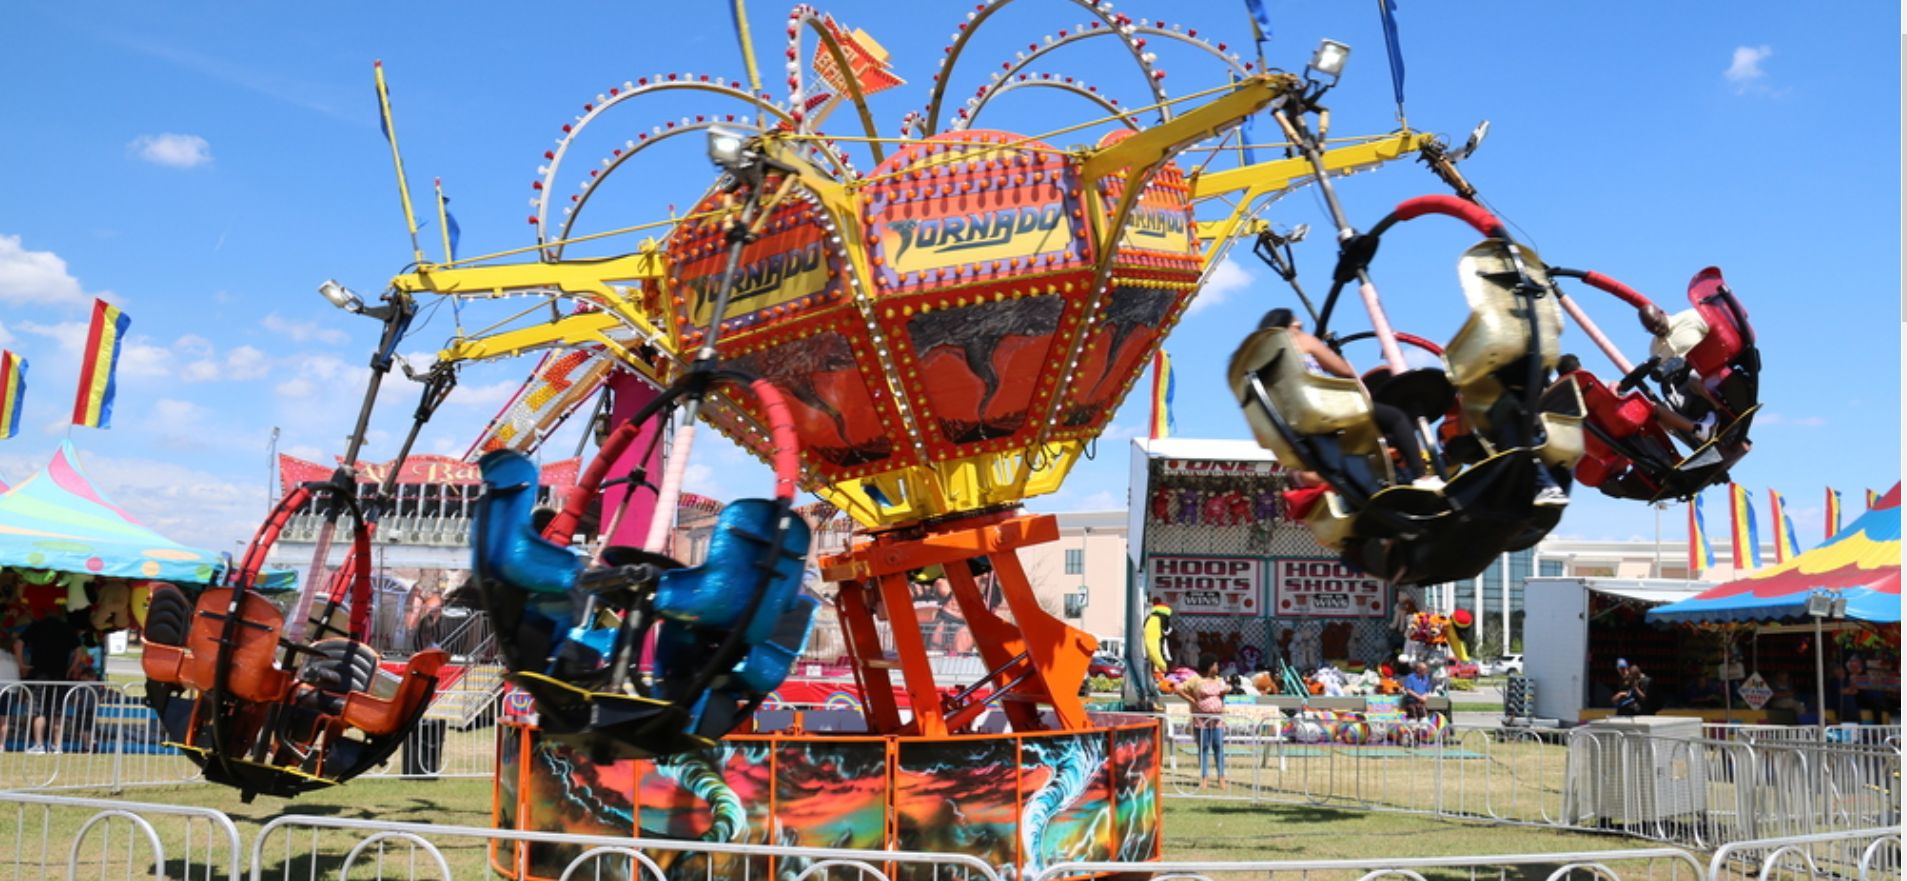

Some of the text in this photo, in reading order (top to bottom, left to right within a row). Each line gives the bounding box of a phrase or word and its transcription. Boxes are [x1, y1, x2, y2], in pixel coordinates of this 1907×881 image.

[1127, 208, 1184, 238] ORNADO
[885, 203, 1064, 264] TORNADO
[1156, 560, 1249, 575] HOOP
[1285, 563, 1364, 578] HOO
[1155, 576, 1249, 590] SHOTS
[1285, 579, 1378, 592] SHOTS
[1186, 596, 1219, 606] WINS
